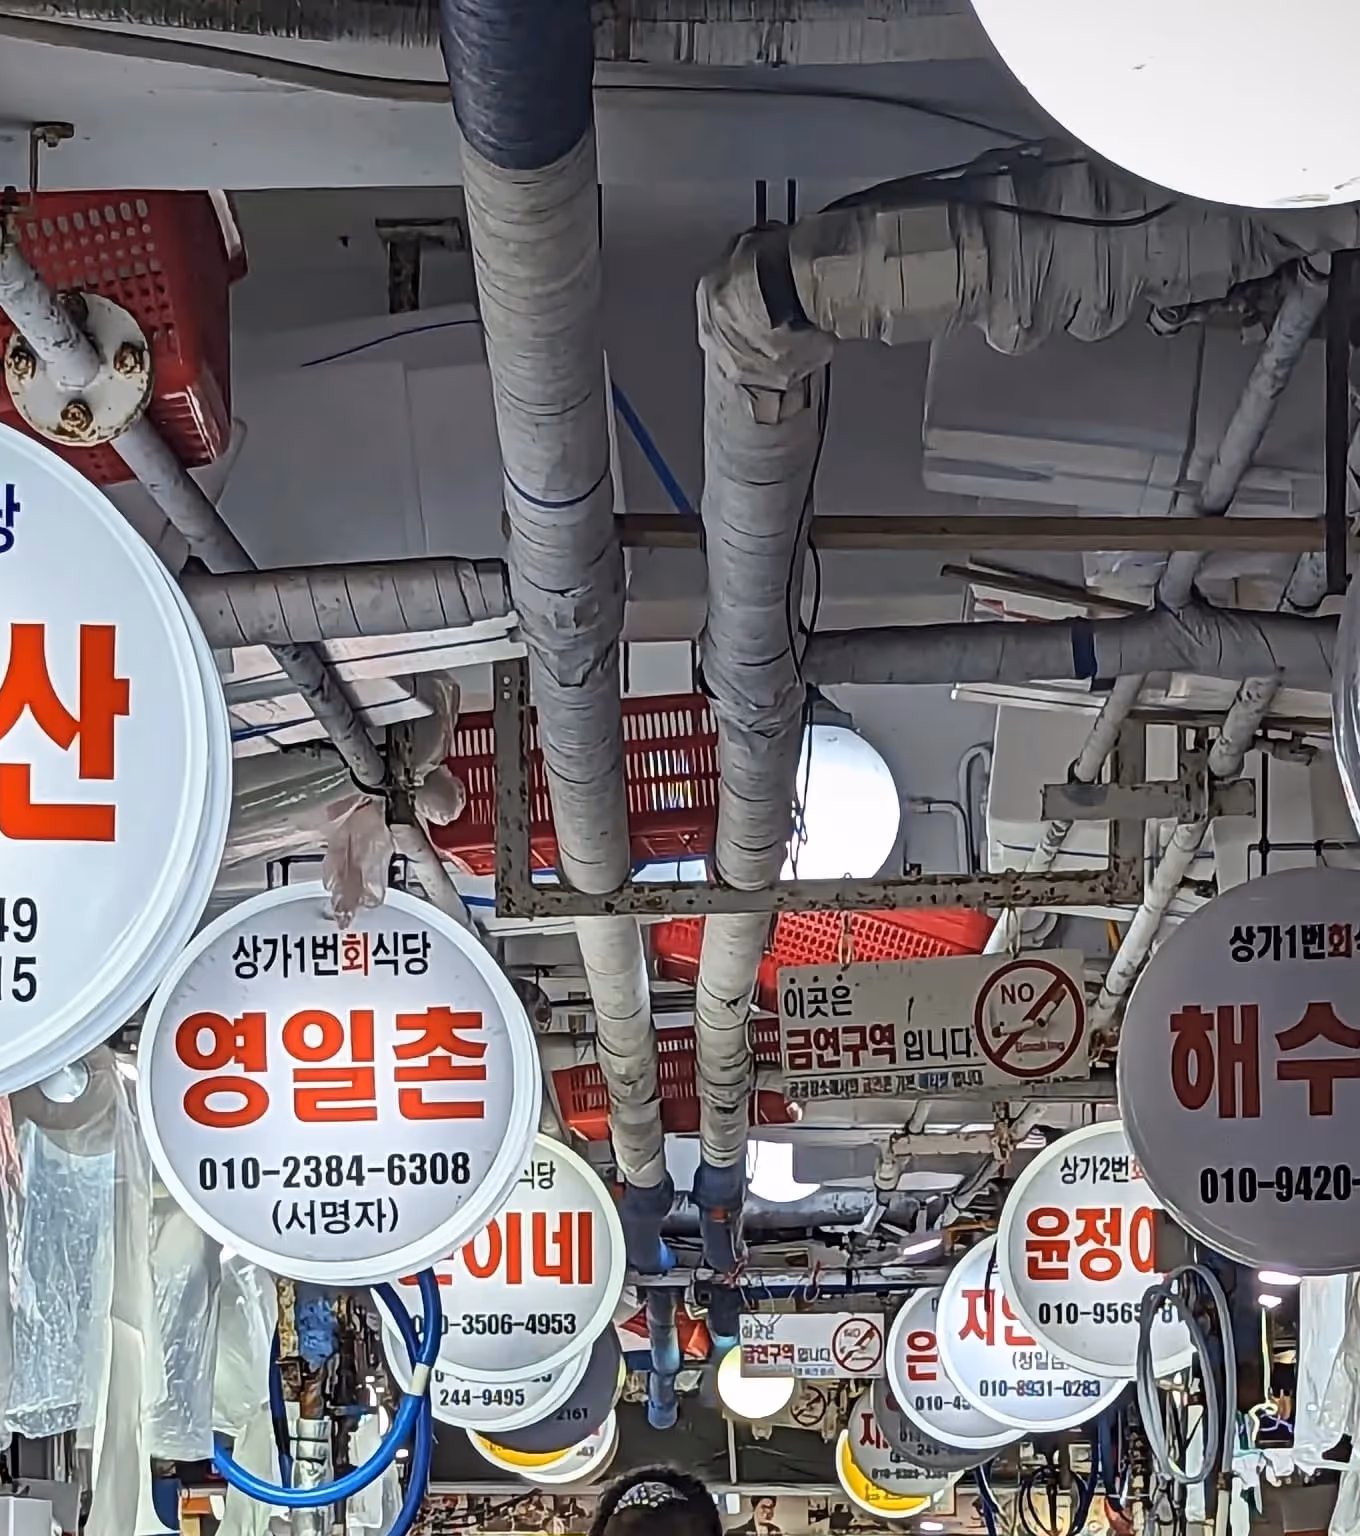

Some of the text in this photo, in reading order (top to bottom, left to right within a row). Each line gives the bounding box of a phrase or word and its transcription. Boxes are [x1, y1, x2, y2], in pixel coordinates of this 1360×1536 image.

[232, 931, 431, 978] 상가1번회식당
[783, 982, 852, 1019] 이곳은
[1000, 983, 1034, 1004] NO
[786, 1023, 896, 1070] 금연구역
[175, 1005, 489, 1128] 영일촌
[199, 1152, 471, 1191] 010-2384-6308
[271, 1197, 400, 1235] (서명자)
[398, 1212, 592, 1286] 이네
[440, 1389, 524, 1406] 244-9495
